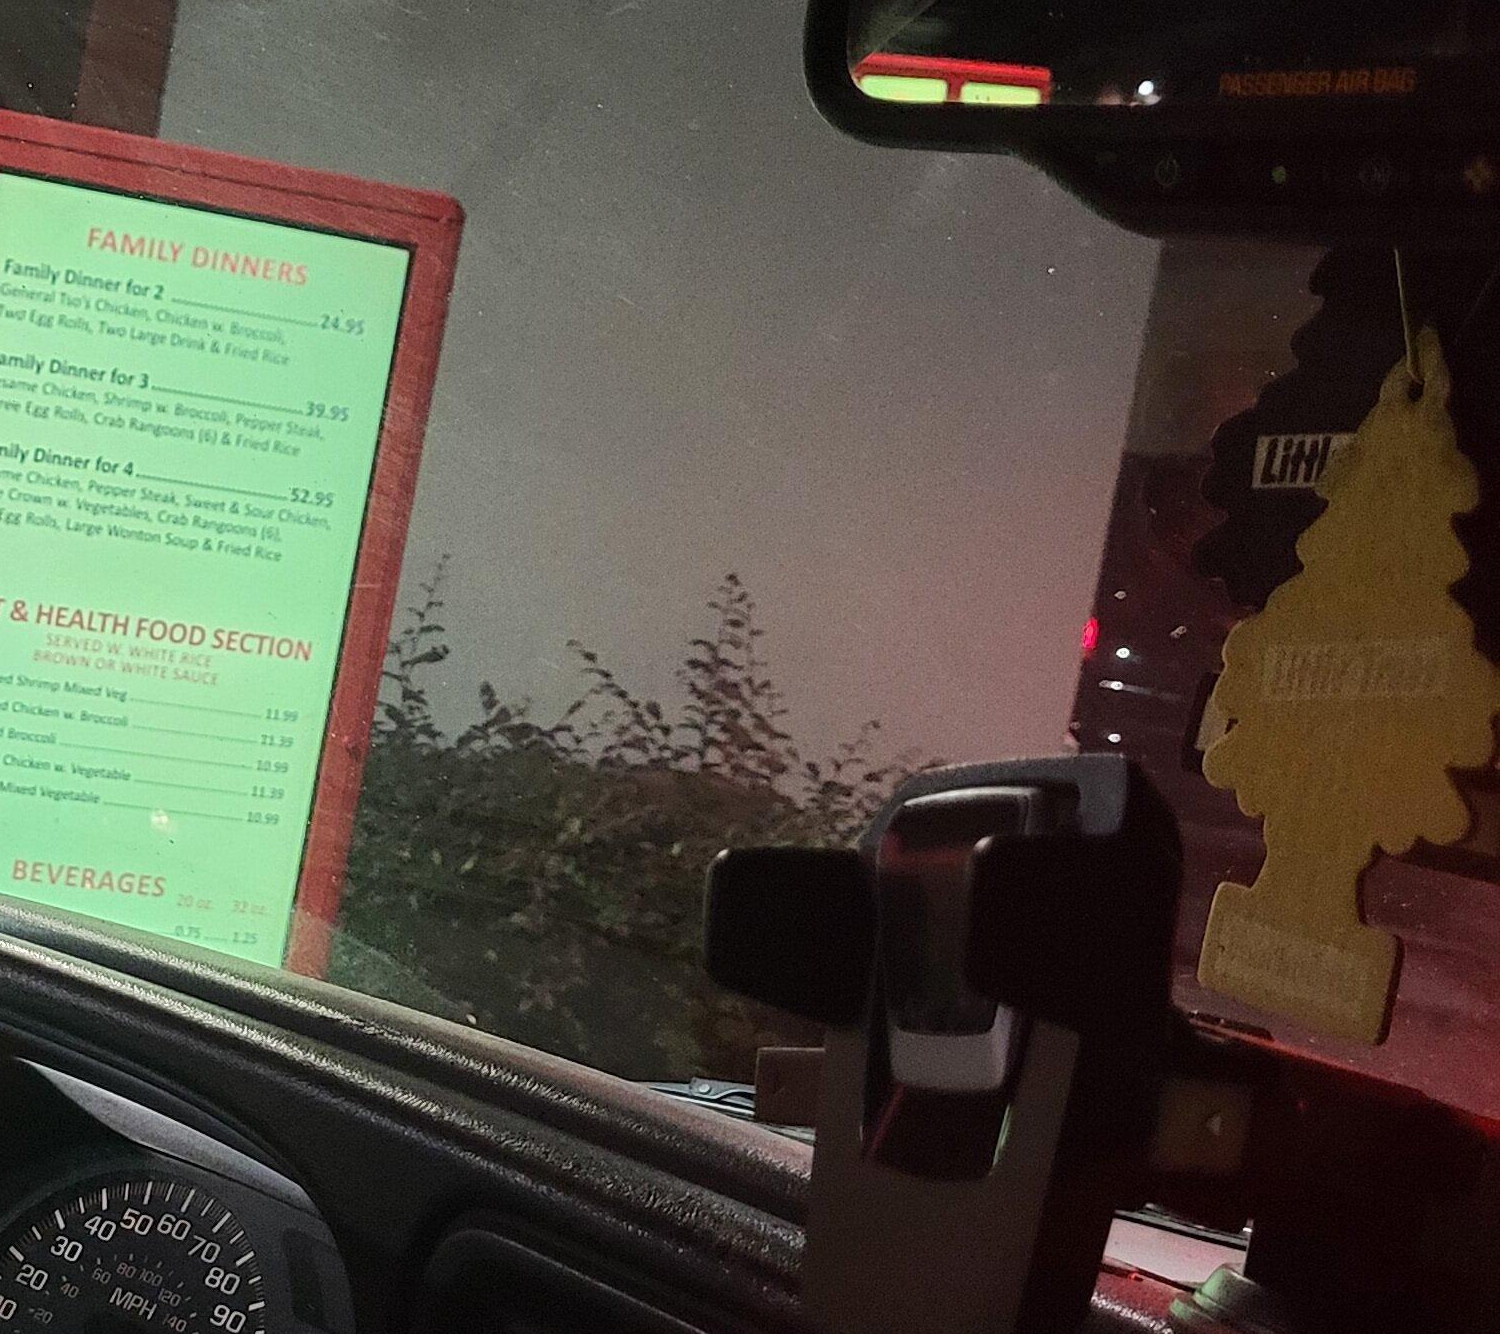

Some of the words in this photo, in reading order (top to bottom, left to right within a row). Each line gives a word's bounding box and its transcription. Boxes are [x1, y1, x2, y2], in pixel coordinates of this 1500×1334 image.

[87, 226, 185, 265] FAMILY
[191, 245, 308, 286] DINNERS
[3, 258, 60, 286] Family
[64, 268, 122, 293] Dinner
[125, 278, 151, 297] for
[153, 284, 165, 301] 2
[320, 314, 365, 336] 24.95
[48, 358, 107, 382] Dinner
[110, 367, 135, 386] for
[138, 373, 150, 390] 3
[305, 401, 350, 423] 39.95
[33, 447, 91, 469] Dinner
[95, 456, 120, 474] for
[122, 461, 134, 477] 4
[290, 487, 334, 508] 52.95
[9, 599, 29, 623] &
[35, 603, 130, 637] HEALTH
[135, 617, 207, 647] FOOD
[211, 628, 313, 662] SECTION
[32, 649, 90, 668] BROWN
[94, 657, 116, 671] OR
[121, 662, 168, 680] WHITE
[172, 667, 218, 686] SAUCE
[46, 633, 103, 653] SERVED
[129, 646, 175, 664] WHITE
[179, 652, 212, 669] RICE
[12, 860, 167, 898] BEVERAGES
[84, 1216, 117, 1242] 40
[120, 1208, 154, 1235] 50
[157, 1213, 191, 1240] 60
[50, 1235, 83, 1262] 30
[187, 1235, 221, 1264] 70
[15, 1264, 49, 1291] 20
[205, 1267, 241, 1295] 80
[109, 1287, 158, 1320] MPH
[210, 1304, 247, 1333] 90
